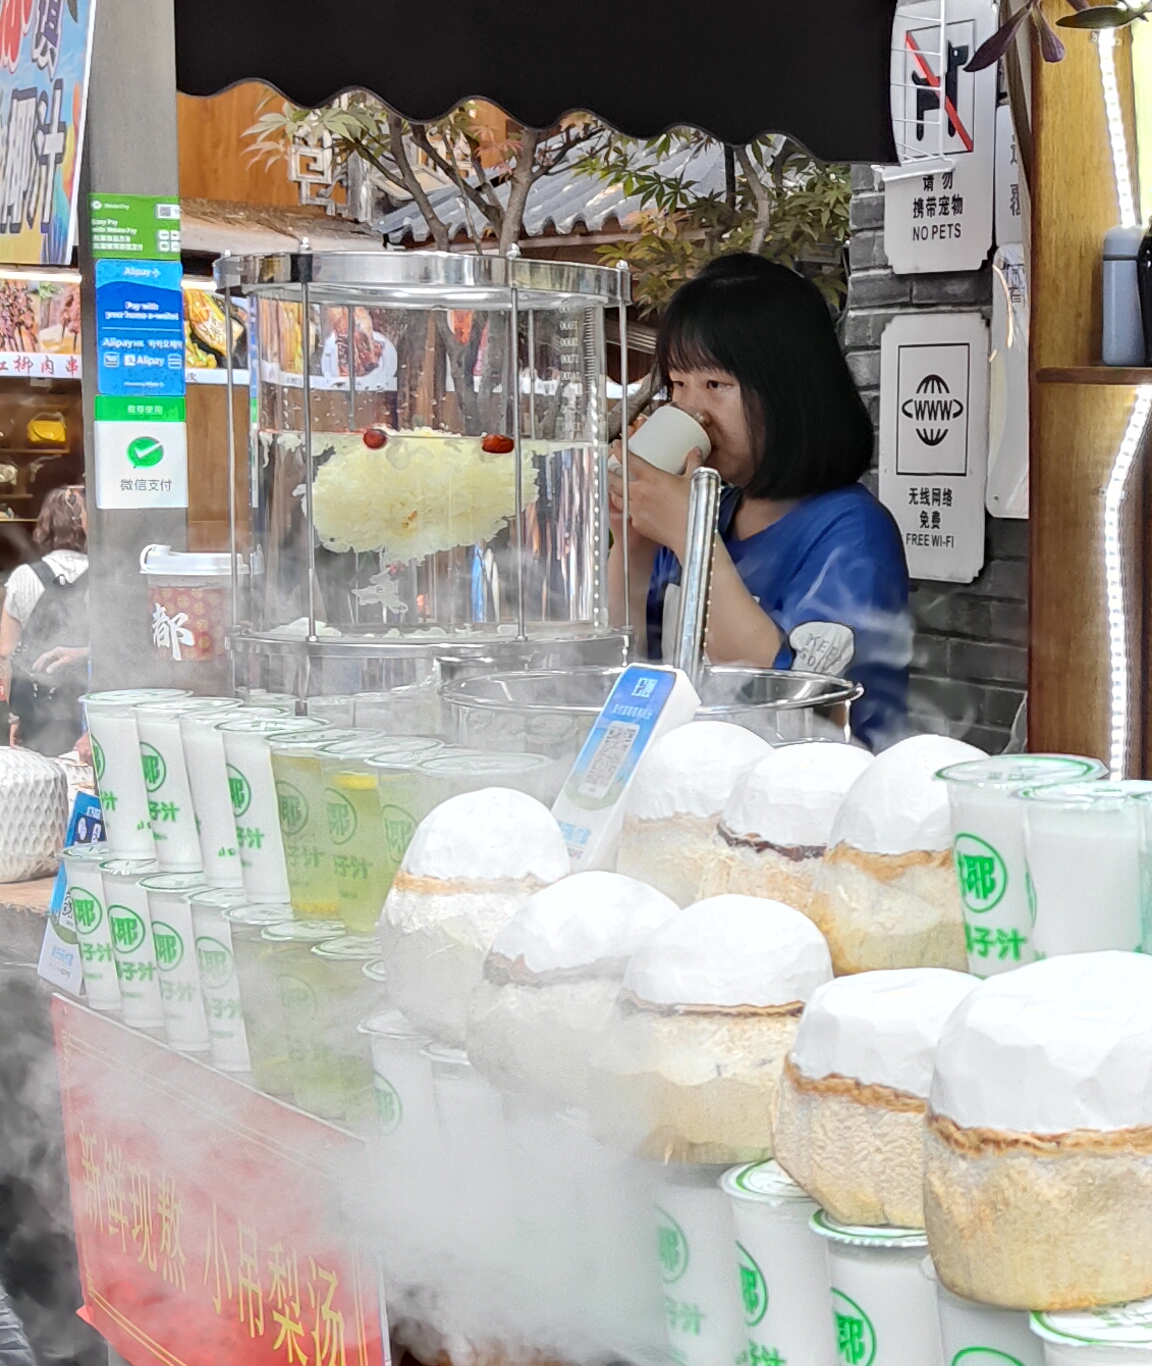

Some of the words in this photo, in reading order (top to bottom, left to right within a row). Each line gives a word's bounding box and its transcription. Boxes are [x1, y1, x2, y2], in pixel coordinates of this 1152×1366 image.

[922, 171, 954, 192] 请勿
[912, 194, 963, 219] 携带宠物
[912, 225, 929, 242] NO
[931, 223, 962, 240] PETS
[914, 399, 953, 422] WWW
[120, 478, 173, 493] 微信支付
[908, 487, 954, 507] 无线网络
[919, 509, 942, 530] 免费
[905, 532, 930, 547] FREE
[932, 534, 955, 549] WI-FI
[151, 602, 195, 662] 都
